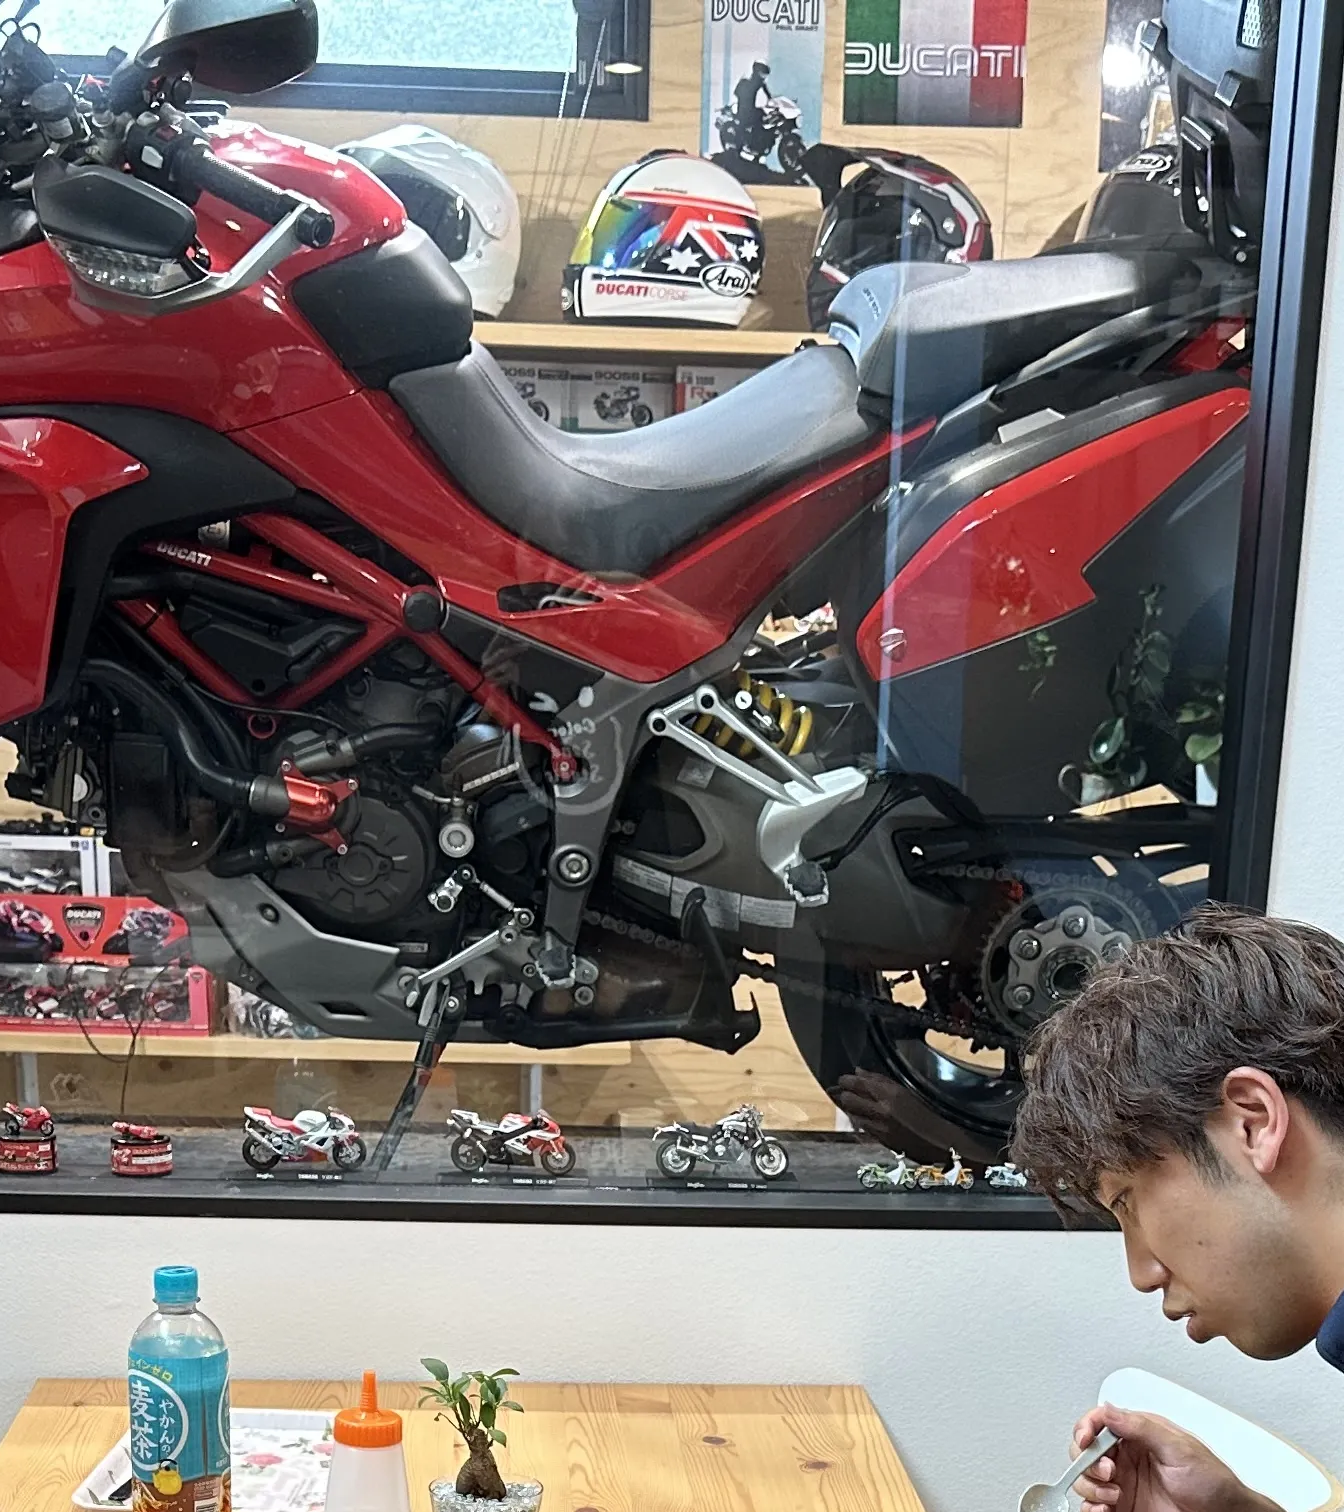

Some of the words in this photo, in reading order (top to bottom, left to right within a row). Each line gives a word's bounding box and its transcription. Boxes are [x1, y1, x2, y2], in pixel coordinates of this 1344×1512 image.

[711, 0, 820, 25] DUCATI
[844, 42, 1027, 78] DUCATI
[595, 282, 649, 298] DUCATI
[705, 268, 750, 290] Arai
[156, 541, 212, 567] DUCATI
[66, 909, 102, 919] DUCATI
[130, 1379, 159, 1460] 麦茶
